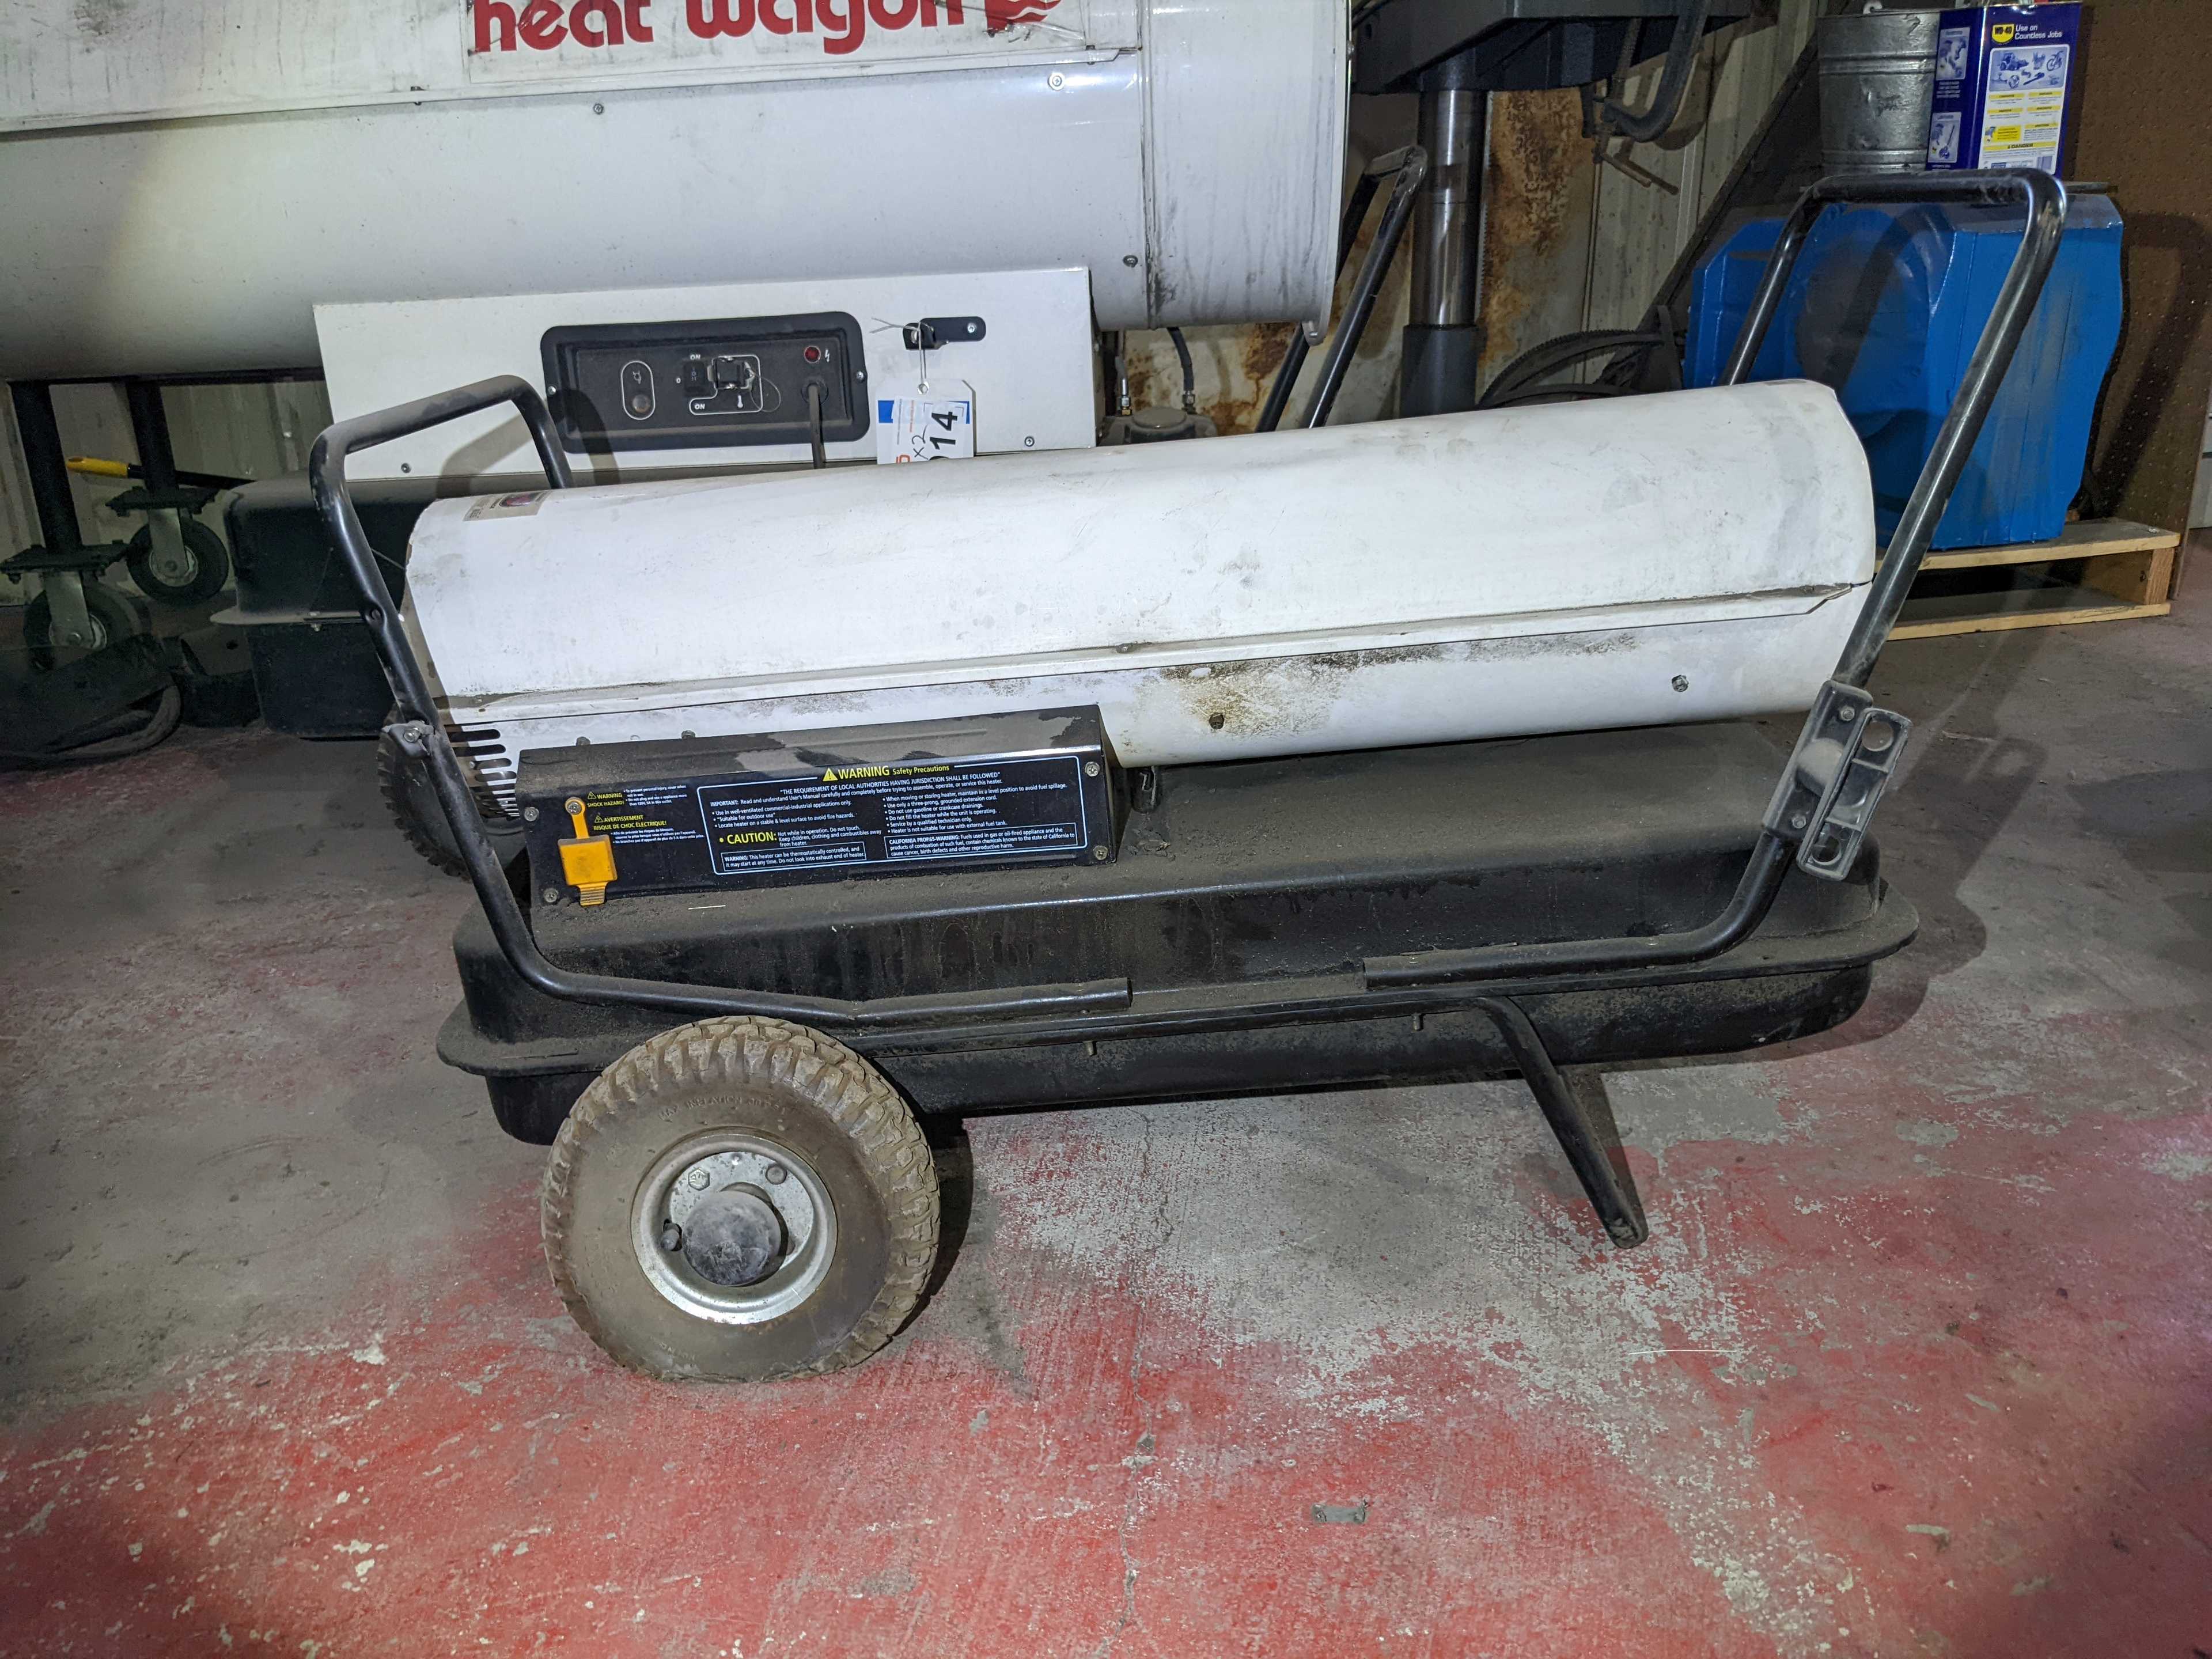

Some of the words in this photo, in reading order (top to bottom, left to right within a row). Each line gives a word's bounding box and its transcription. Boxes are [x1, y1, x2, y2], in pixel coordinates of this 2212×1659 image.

[474, 0, 654, 52] heat
[687, 0, 965, 55] wagon
[930, 411, 958, 460] 14
[839, 766, 889, 779] WARNING
[764, 803, 812, 811] commercial-industrial
[727, 831, 777, 844] CAUTION:
